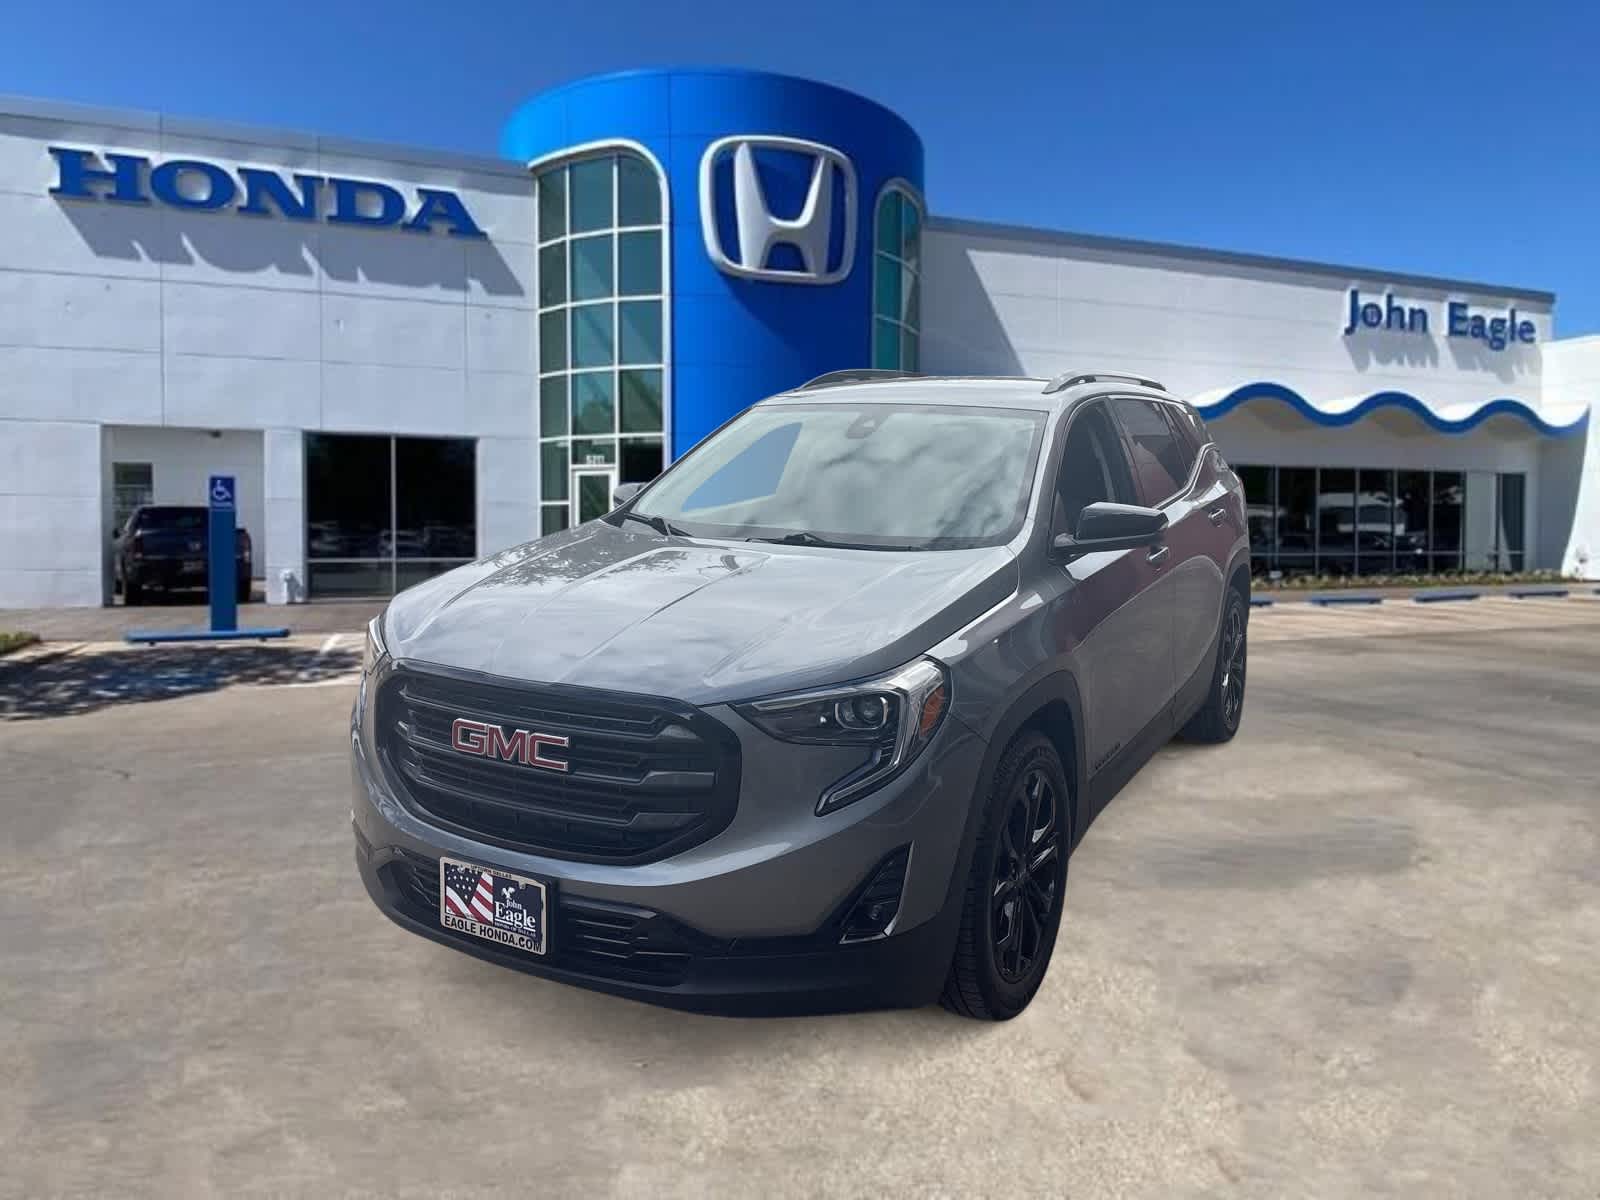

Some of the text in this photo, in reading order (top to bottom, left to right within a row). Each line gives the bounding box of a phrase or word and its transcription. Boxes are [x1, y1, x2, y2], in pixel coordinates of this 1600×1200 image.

[48, 146, 488, 239] HONDA
[1344, 288, 1537, 351] John Eagle
[452, 717, 569, 772] GMC
[494, 900, 536, 929] Eagle
[505, 898, 522, 910] John
[444, 915, 542, 953] EAGLE HONDA.COM
